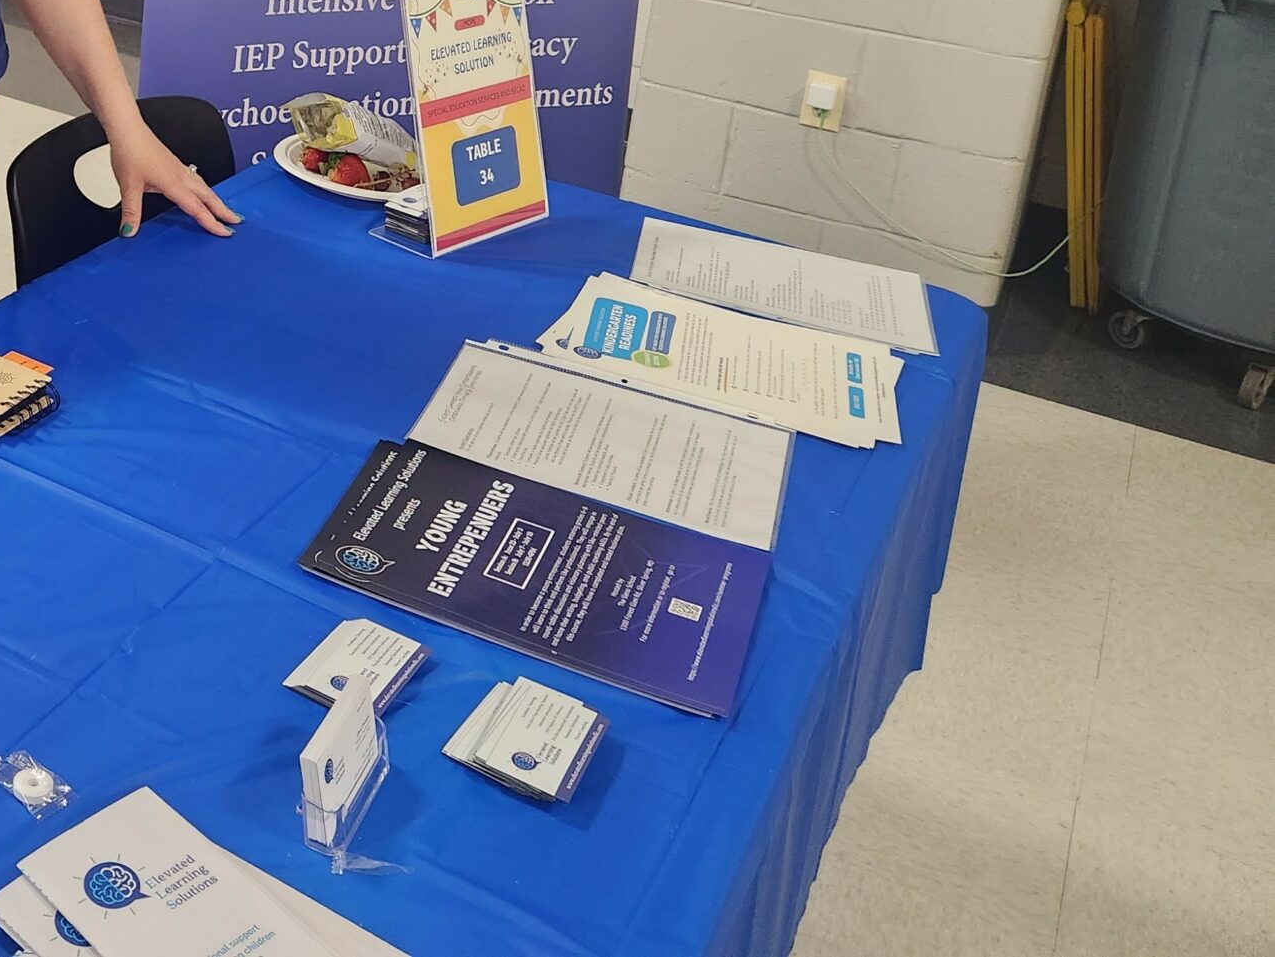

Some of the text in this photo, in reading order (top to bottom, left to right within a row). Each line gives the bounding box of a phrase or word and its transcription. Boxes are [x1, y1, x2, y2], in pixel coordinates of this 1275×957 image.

[430, 42, 471, 61] ELEVATED
[473, 32, 512, 51] LEARNING
[232, 39, 406, 78] IEP Support
[455, 55, 494, 75] SOLUTION
[427, 104, 448, 118] SPECIAL
[449, 98, 475, 114] EDUCATION
[476, 92, 500, 109] SERVICES
[466, 138, 501, 161] TABLE
[479, 168, 494, 186] 34
[602, 303, 624, 353] KINDERGARTEN
[619, 313, 637, 350] READINESS
[353, 509, 384, 541] Elevated
[376, 481, 408, 510] Learning
[397, 449, 426, 481] Solutions
[393, 498, 421, 530] presents
[416, 500, 468, 552] YOUNG
[427, 480, 514, 597] ENTREPENUERS
[576, 534, 587, 544] They
[609, 534, 621, 550] business
[554, 593, 569, 614] discussions
[565, 585, 573, 593] and
[577, 552, 590, 569] planning
[599, 514, 608, 524] peers
[601, 560, 609, 569] and
[604, 549, 614, 561] tested
[523, 615, 532, 627] order
[530, 595, 543, 610] become
[541, 580, 553, 593] young
[560, 540, 571, 556] students
[568, 525, 581, 540] entering
[575, 513, 585, 526] grades
[592, 568, 605, 588] completed
[626, 575, 637, 588] School
[550, 590, 558, 599] and
[554, 576, 565, 592] perform
[544, 599, 554, 609] think
[551, 637, 560, 646] and
[586, 563, 596, 575] public
[592, 547, 605, 563] speaking
[582, 601, 590, 609] will
[584, 591, 594, 602] have
[624, 607, 635, 620] Forest
[636, 580, 646, 591] Silver
[535, 614, 546, 625] learn
[577, 609, 588, 619] they
[646, 600, 661, 623] information
[532, 625, 540, 633] will
[566, 633, 574, 641] this
[644, 623, 652, 634] more
[145, 854, 196, 889] Elevated
[155, 865, 209, 899] Learning
[166, 876, 218, 909] Solutions
[229, 924, 260, 947] support
[244, 931, 275, 954] children
